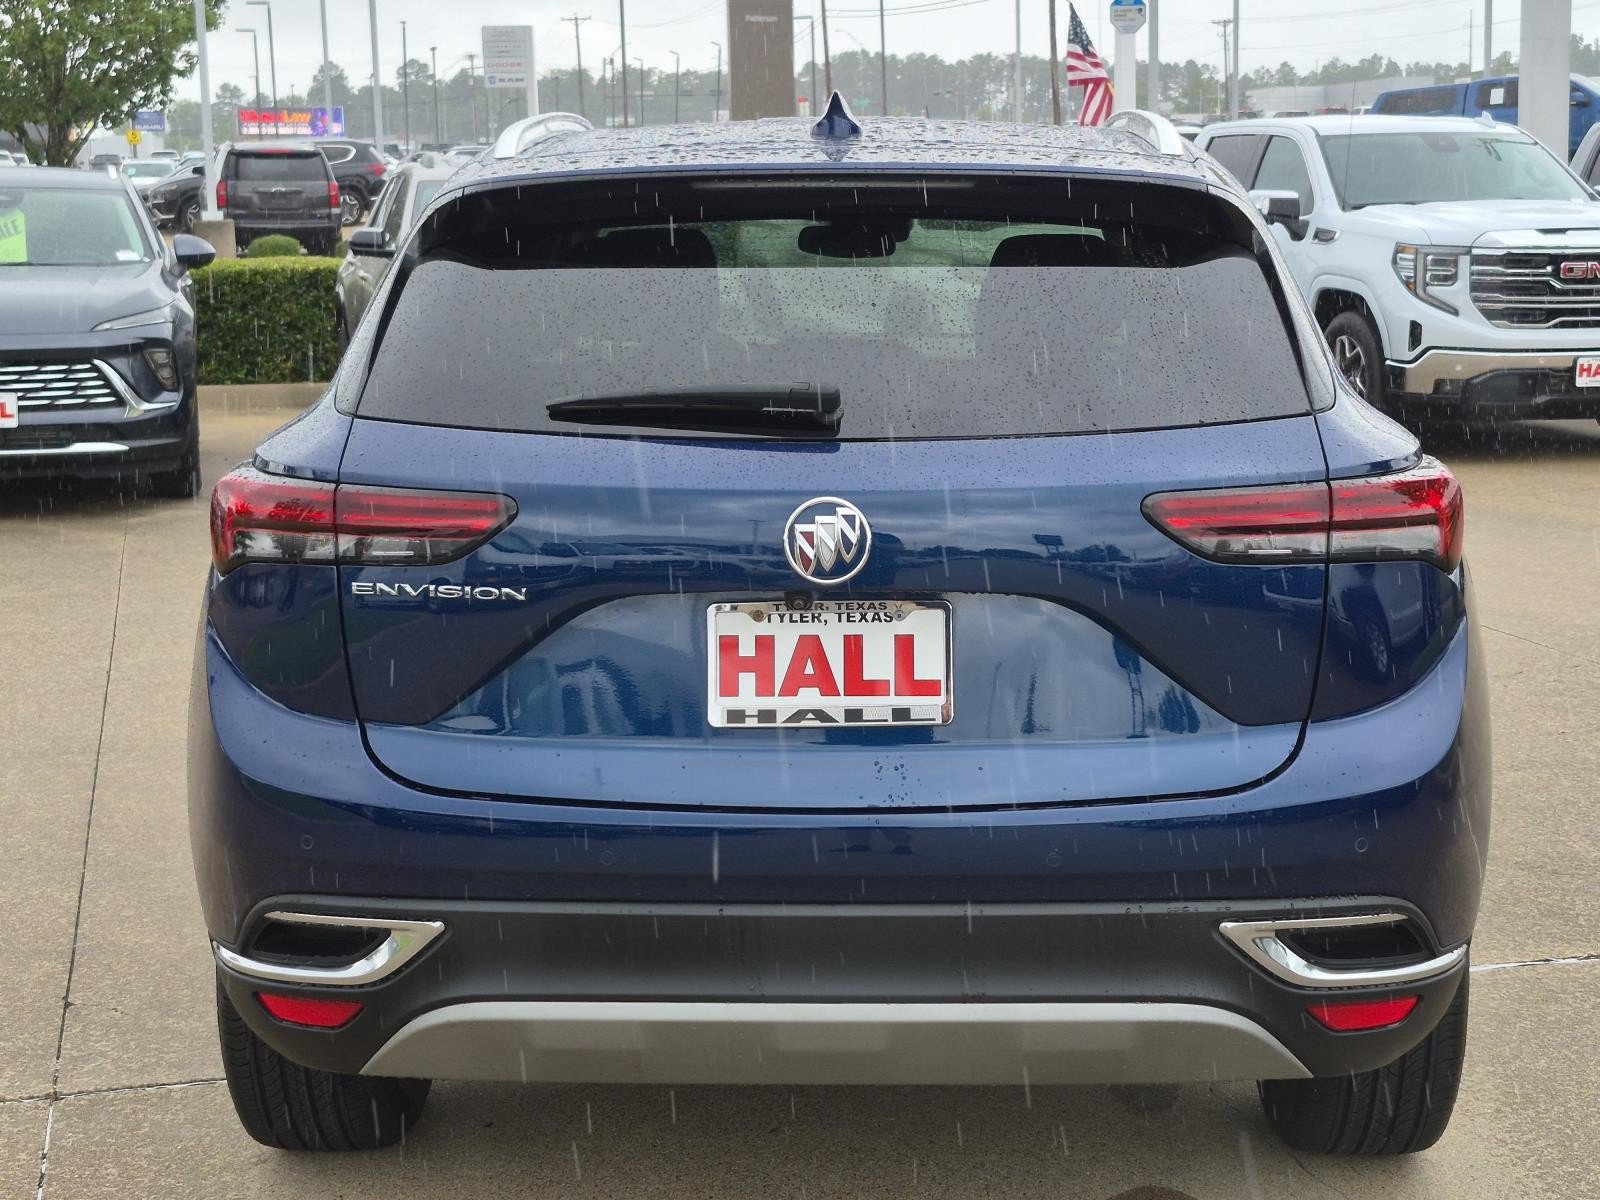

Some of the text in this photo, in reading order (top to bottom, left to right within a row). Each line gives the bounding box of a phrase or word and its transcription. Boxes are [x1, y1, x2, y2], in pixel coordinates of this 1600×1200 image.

[351, 581, 527, 602] ENVISION
[835, 601, 888, 611] TEXAS
[766, 612, 894, 625] TYLER, TEXAS
[719, 634, 942, 697] HALL
[726, 707, 937, 724] HALL
